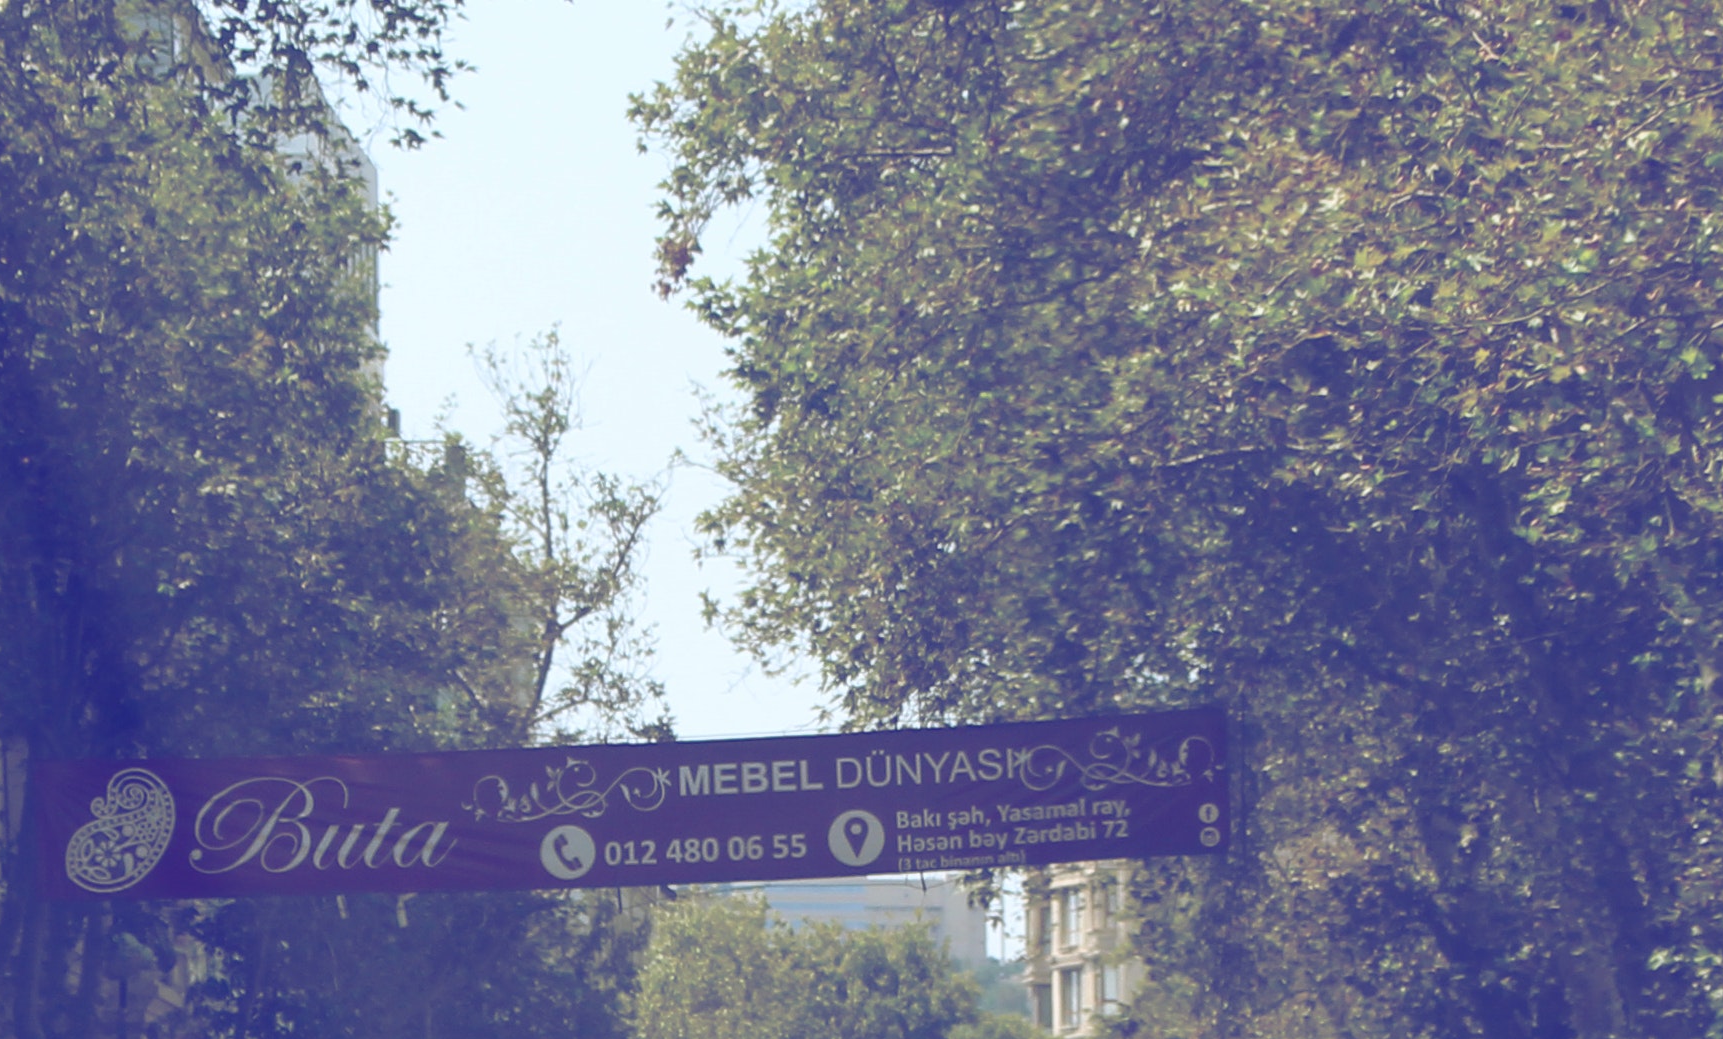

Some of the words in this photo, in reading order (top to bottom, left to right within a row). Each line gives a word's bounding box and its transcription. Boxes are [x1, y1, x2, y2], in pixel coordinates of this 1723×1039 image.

[678, 761, 824, 796] MEBEL
[834, 749, 1016, 790] DÜNYASI
[188, 776, 458, 874] Buta
[896, 809, 941, 830] Bakı
[947, 803, 991, 832] şəh,
[996, 798, 1086, 823] Yasamal
[1092, 799, 1132, 818] ray,
[604, 840, 658, 866] 012
[665, 838, 720, 863] 480
[727, 835, 765, 861] 06
[772, 832, 807, 859] 55
[897, 833, 963, 854] Həsən
[969, 829, 1008, 851] bəy
[1013, 820, 1097, 846] Zərdabi
[1102, 819, 1129, 839] 72
